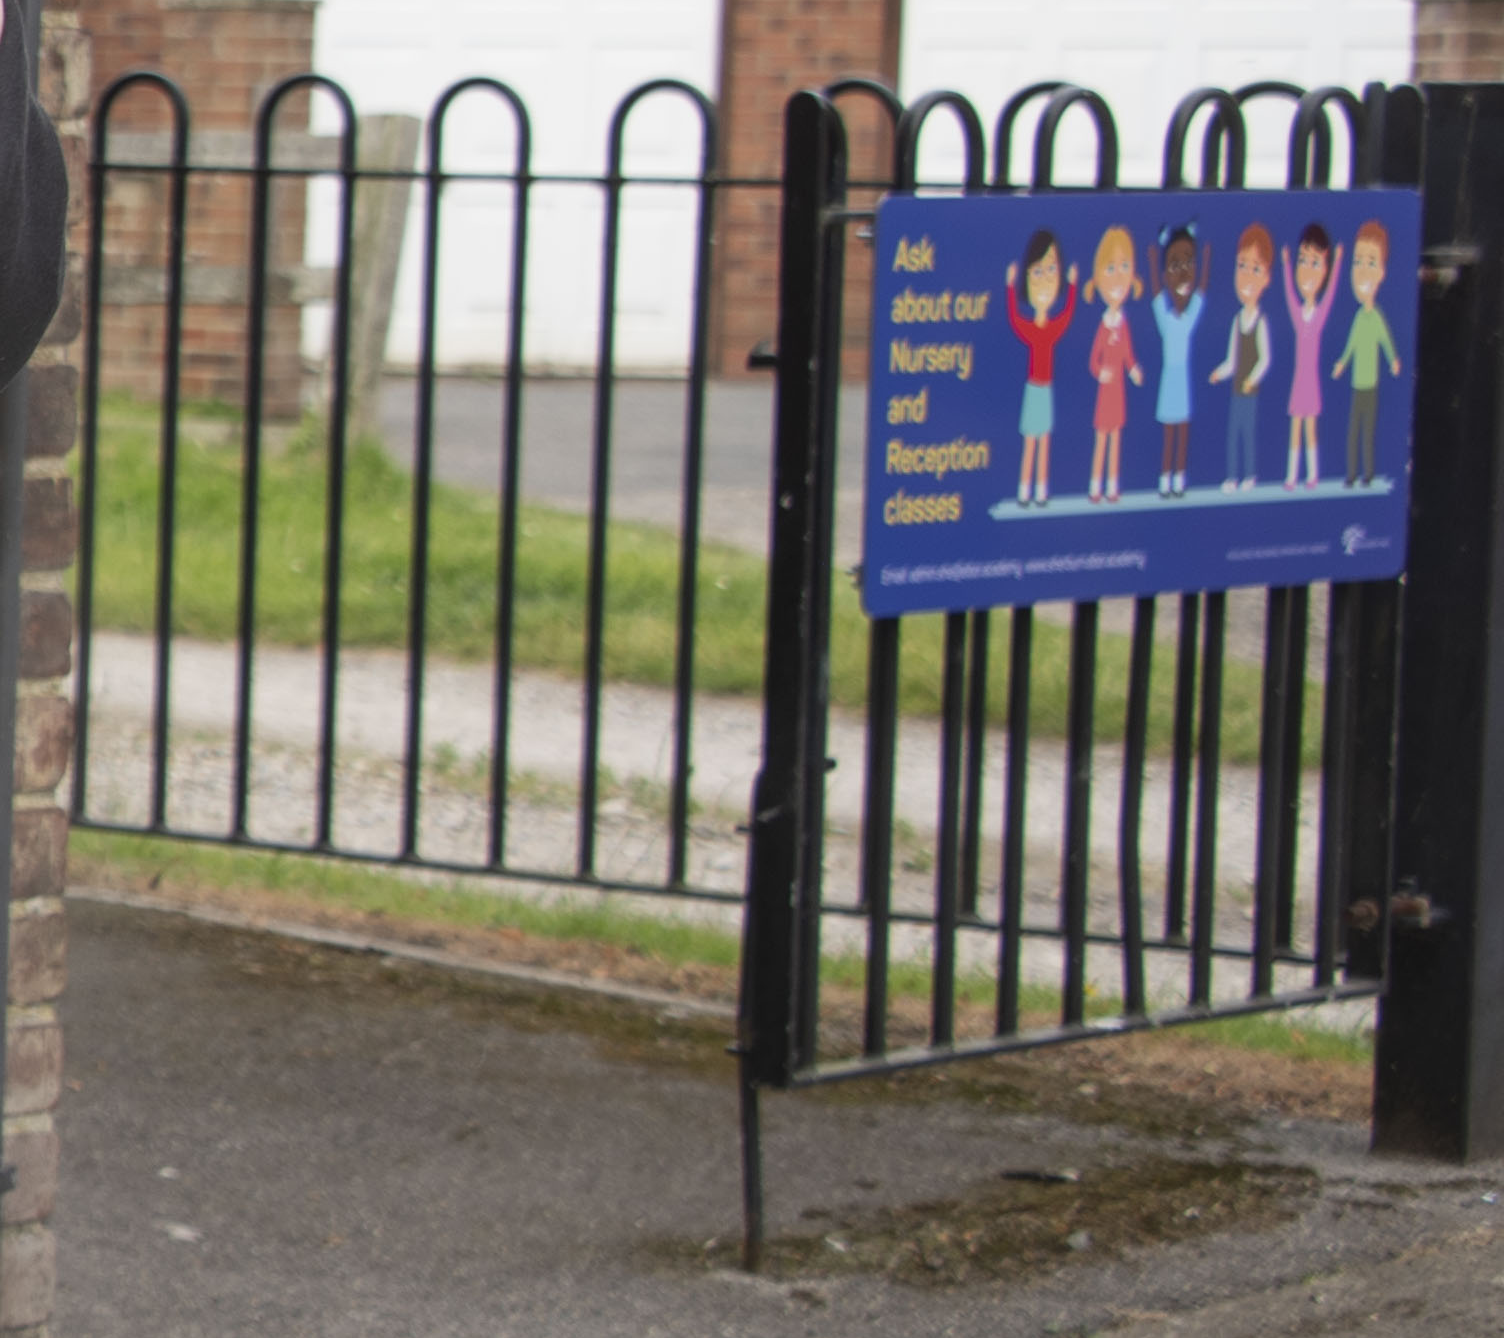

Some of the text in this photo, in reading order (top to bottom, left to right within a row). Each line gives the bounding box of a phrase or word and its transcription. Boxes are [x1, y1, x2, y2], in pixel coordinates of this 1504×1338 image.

[893, 235, 935, 273] Ask
[891, 288, 990, 323] about our
[889, 339, 974, 380] Nursery
[887, 387, 929, 424] and
[885, 438, 991, 479] Reception
[883, 489, 963, 526] classes
